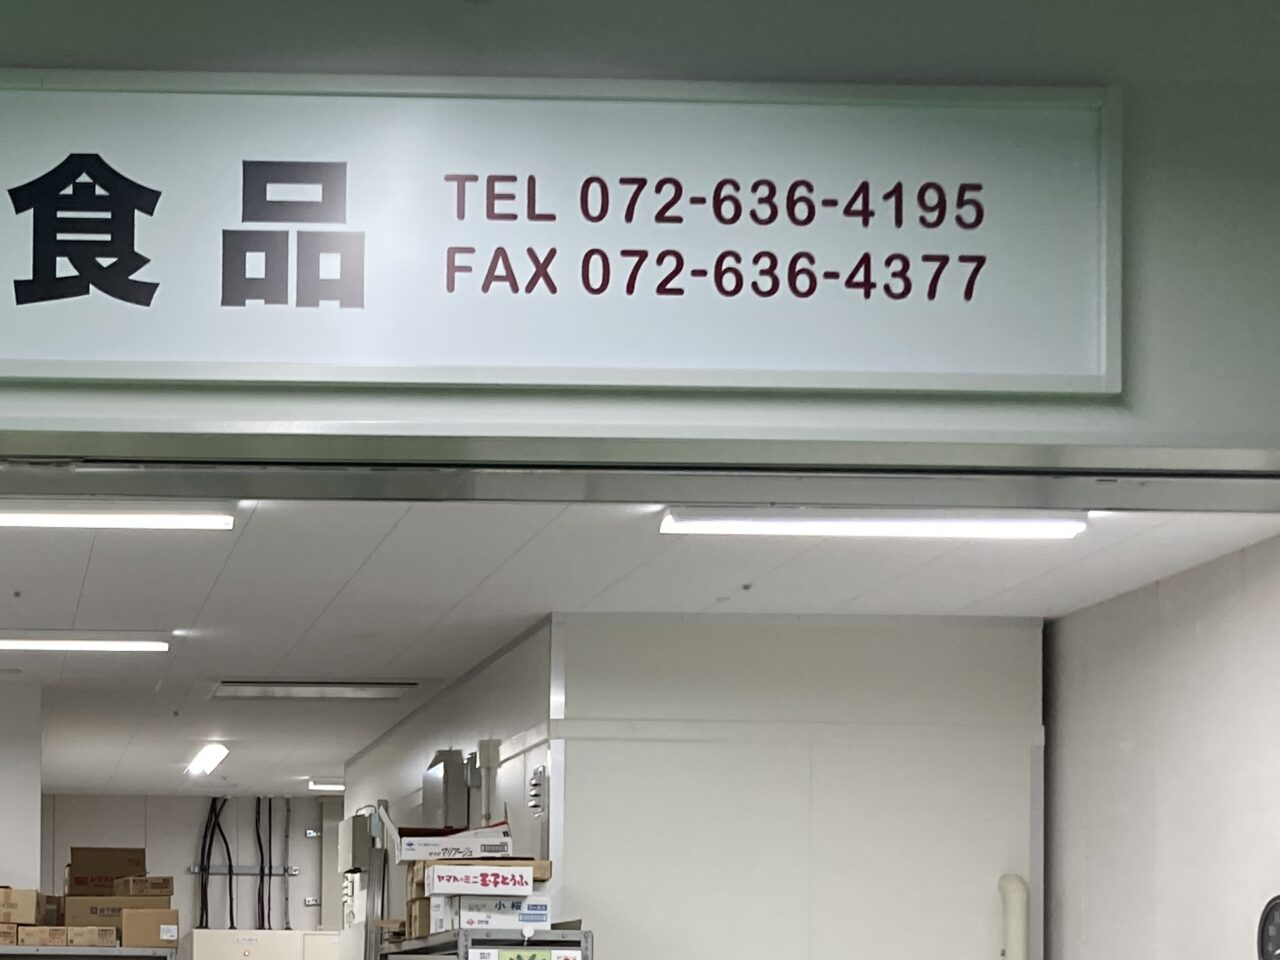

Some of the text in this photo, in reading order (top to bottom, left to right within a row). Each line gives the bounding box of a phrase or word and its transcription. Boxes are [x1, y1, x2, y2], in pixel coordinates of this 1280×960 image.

[445, 174, 986, 231] TEL 072-636-4195
[447, 246, 988, 302] FAX 072-636-4377
